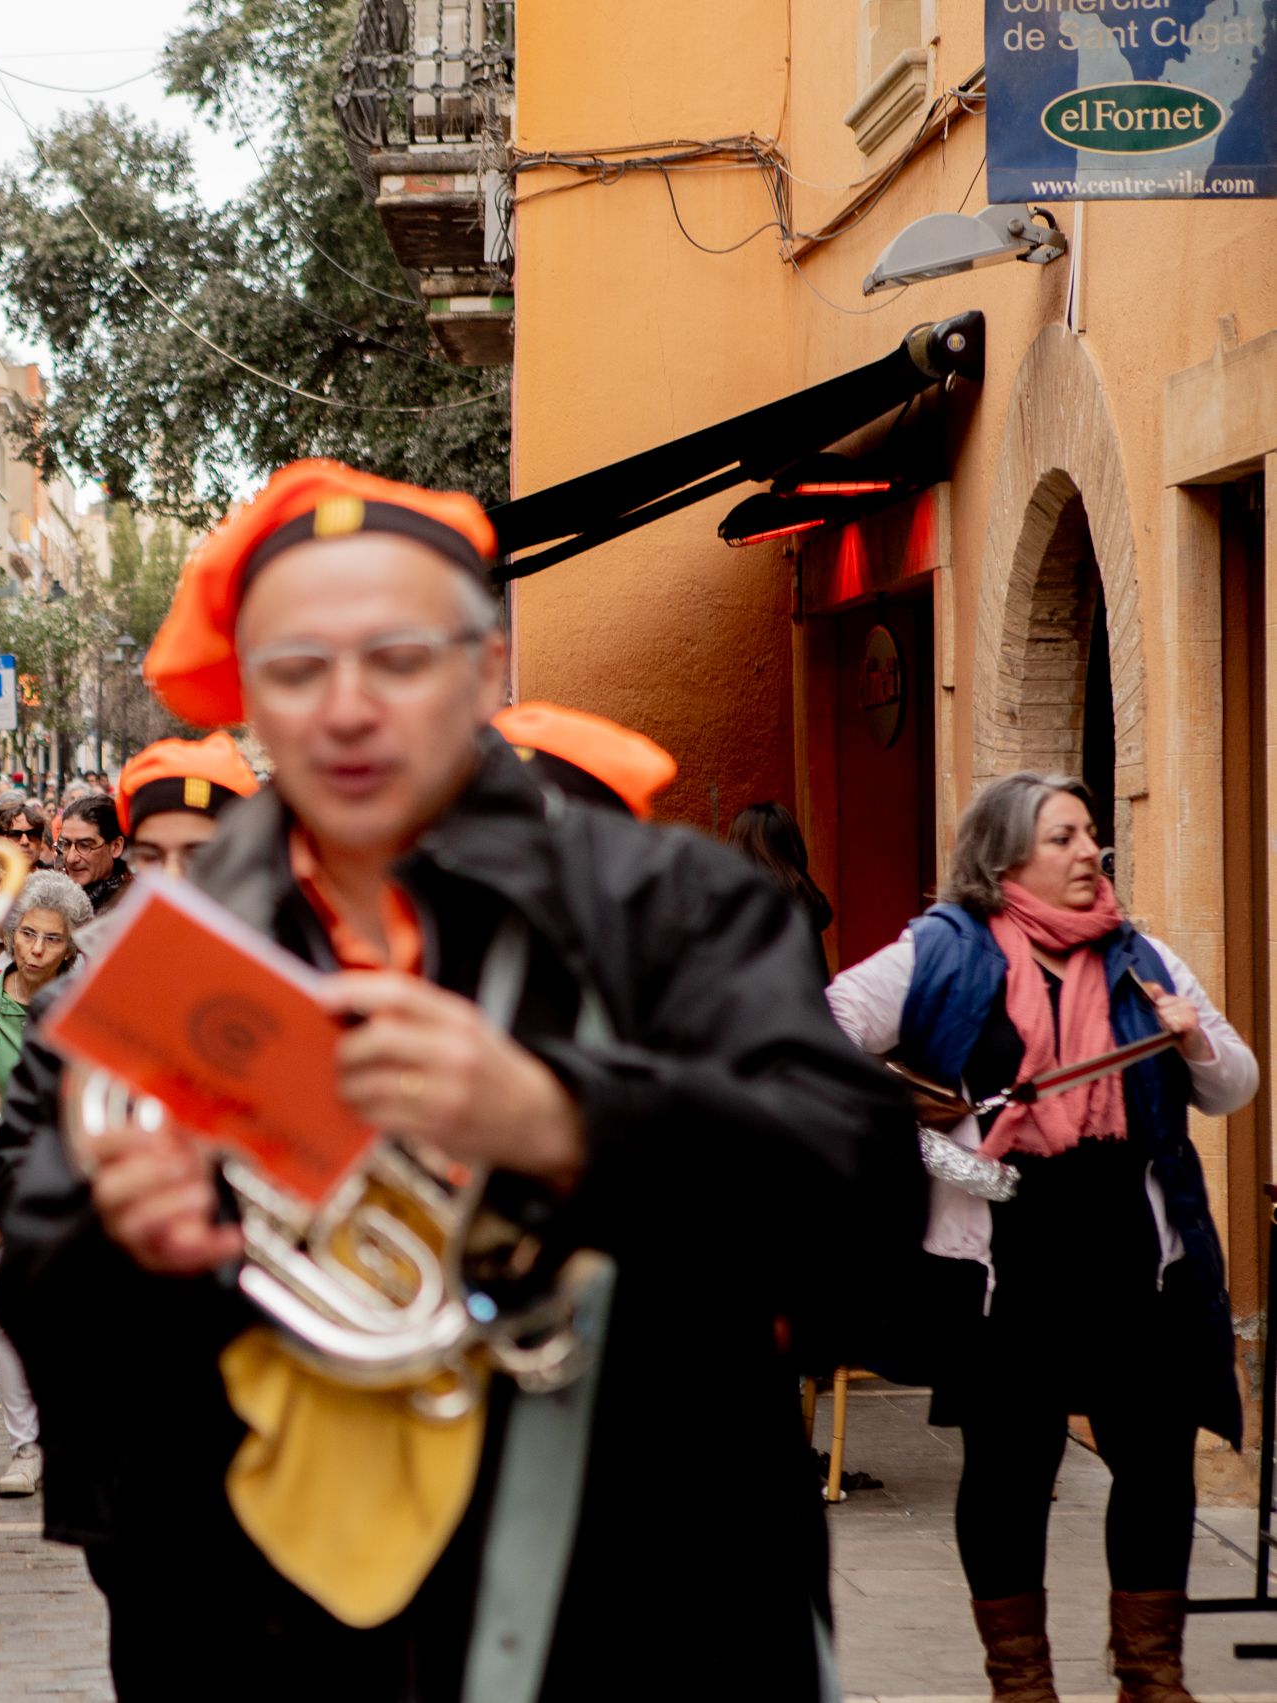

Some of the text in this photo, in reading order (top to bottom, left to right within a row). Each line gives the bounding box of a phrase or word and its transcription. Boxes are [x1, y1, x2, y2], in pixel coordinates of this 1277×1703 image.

[1003, 0, 1171, 13] comerc
[1003, 17, 1255, 54] de Sant Cugat
[1031, 171, 1256, 196] www.centre-vila.com
